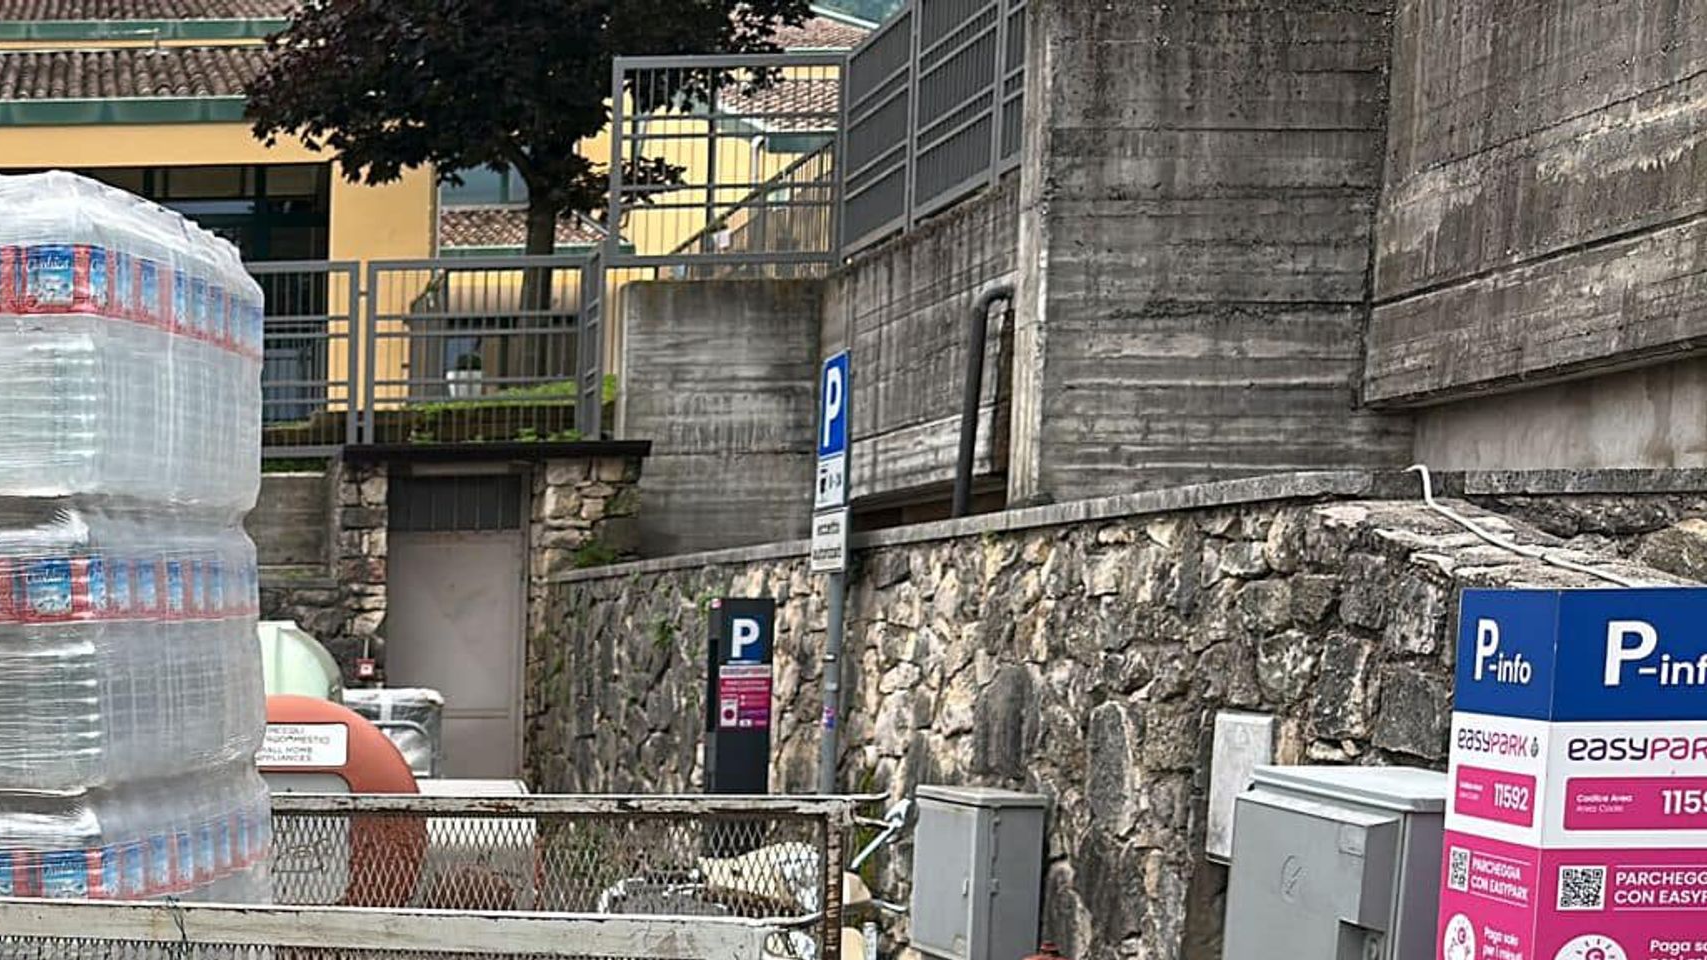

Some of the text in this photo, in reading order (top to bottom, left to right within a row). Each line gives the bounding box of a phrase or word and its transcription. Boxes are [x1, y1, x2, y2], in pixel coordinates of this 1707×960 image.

[823, 367, 842, 447] P
[732, 619, 760, 658] P
[1474, 619, 1532, 684] P-info
[1494, 783, 1529, 811] 11592
[1614, 890, 1655, 904] CON
[1650, 940, 1691, 955] Paga
